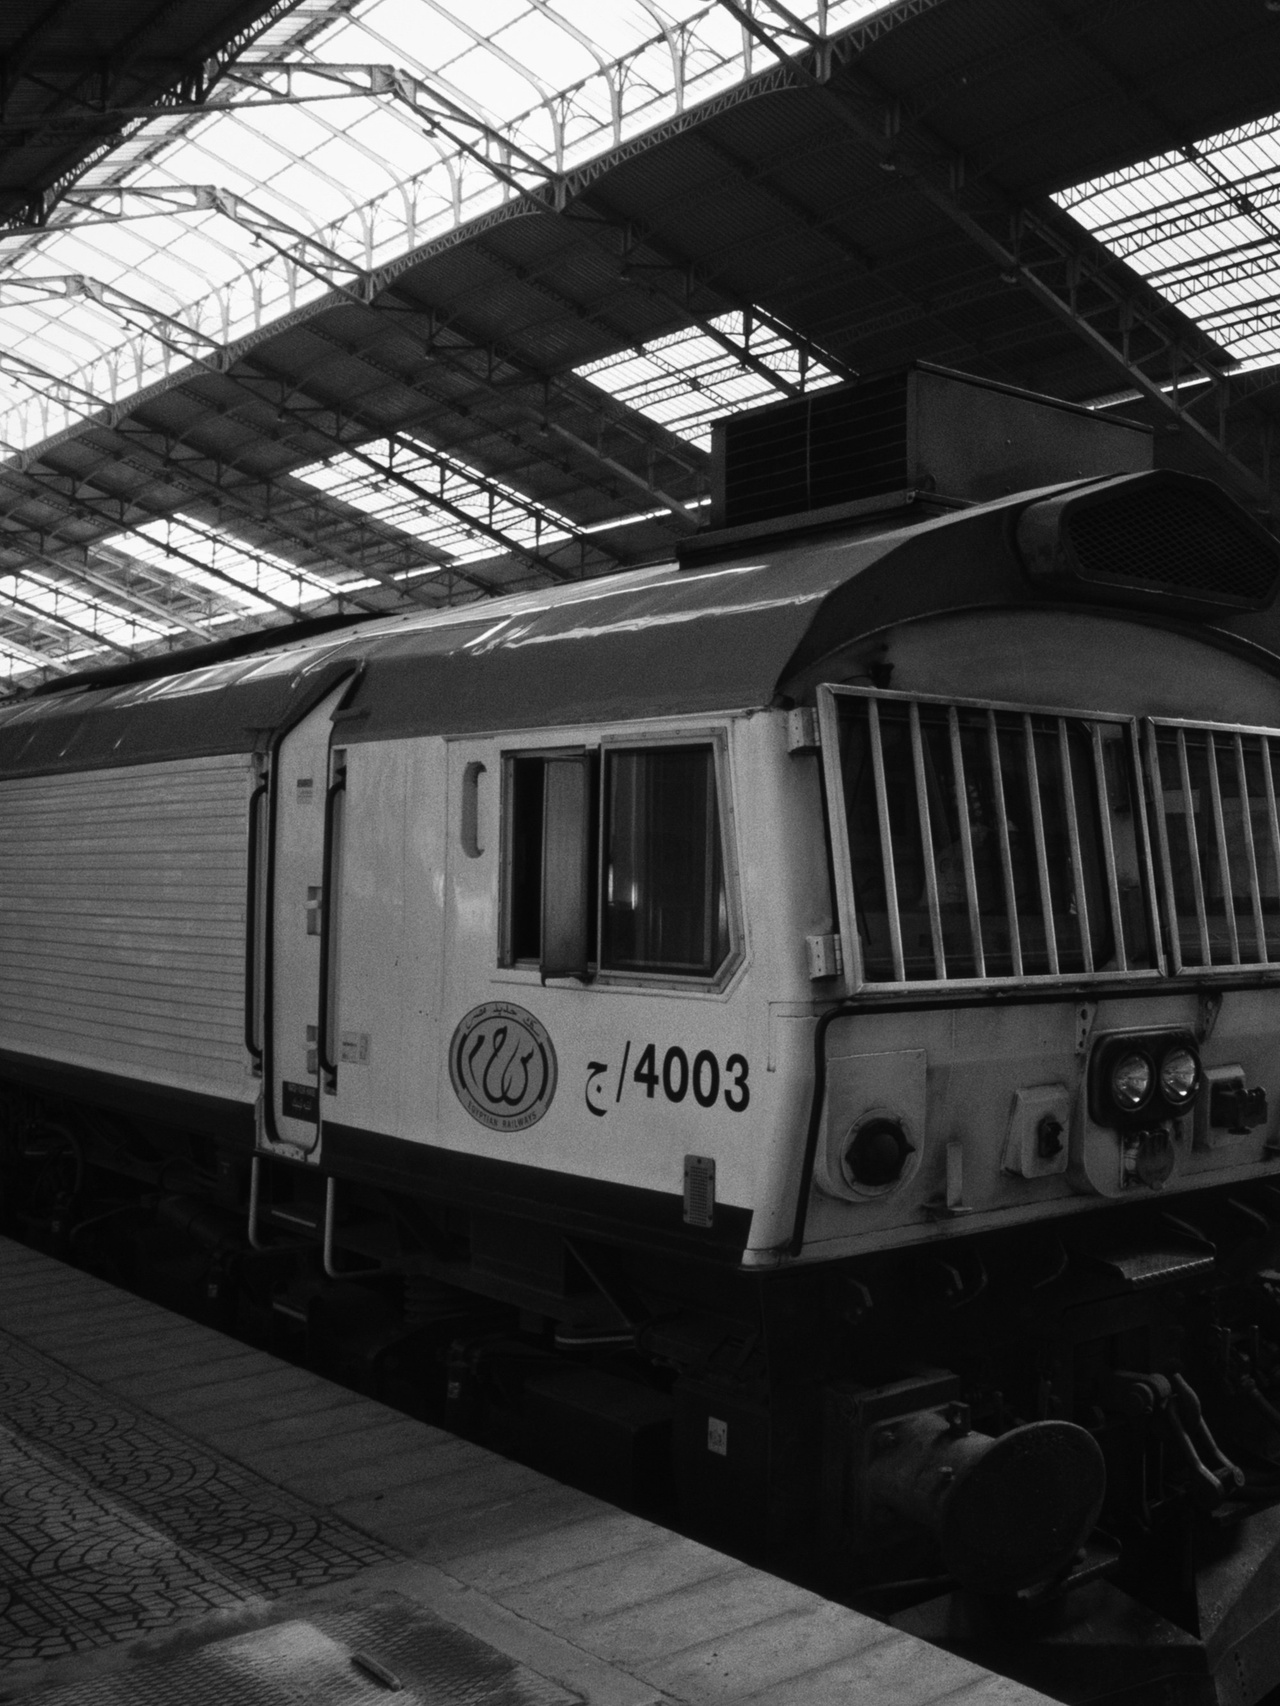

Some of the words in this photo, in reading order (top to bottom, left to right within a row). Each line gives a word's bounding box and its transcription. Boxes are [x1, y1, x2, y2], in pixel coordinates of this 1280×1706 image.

[493, 1004, 518, 1017] حديد
[467, 1101, 499, 1127] EGYPTIAN
[502, 1111, 538, 1129] RAILWAYS
